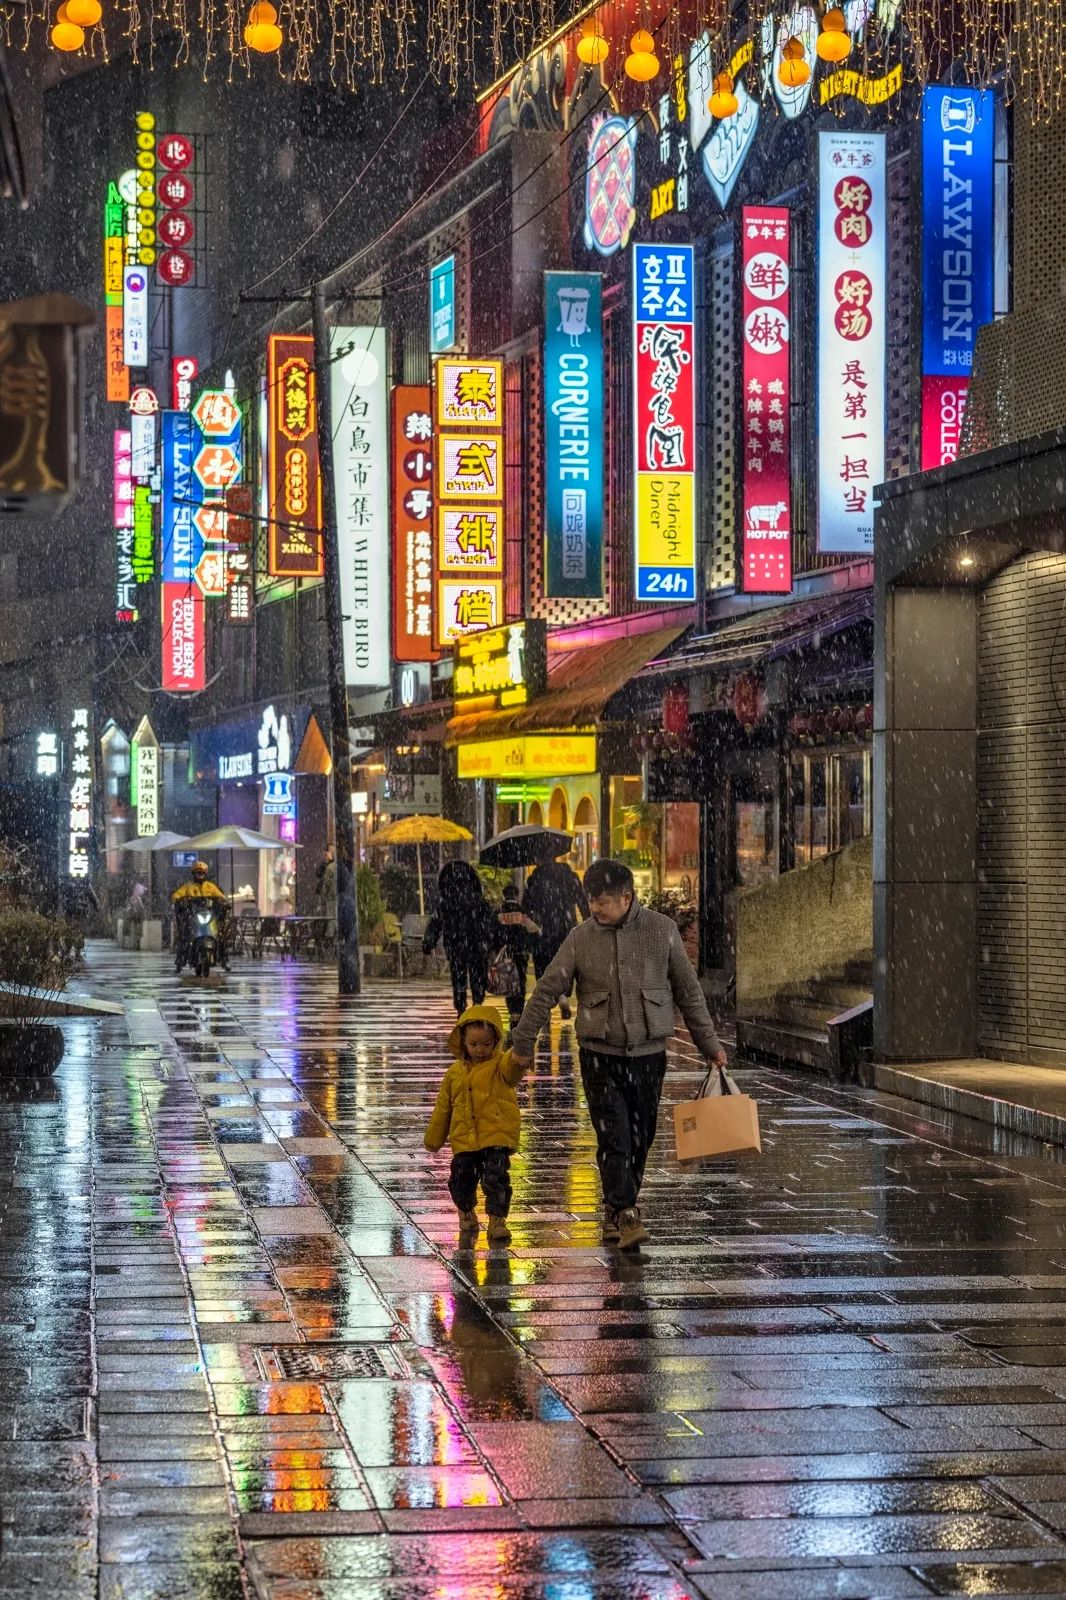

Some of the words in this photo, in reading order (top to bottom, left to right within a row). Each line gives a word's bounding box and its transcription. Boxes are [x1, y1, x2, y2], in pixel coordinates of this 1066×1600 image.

[650, 178, 676, 220] ART
[838, 180, 868, 243] 好肉
[642, 255, 686, 285] 호프
[943, 139, 972, 341] LAWSON
[641, 286, 687, 316] 주소
[838, 277, 868, 337] 好汤
[551, 354, 589, 480] CORNERIE
[839, 360, 869, 513] 是第一担当
[348, 395, 372, 526] 白鳥市集
[173, 442, 191, 563] LAWSON
[650, 481, 664, 528] Diner
[663, 481, 681, 560] Midnight
[747, 530, 768, 539] HOT
[769, 531, 789, 539] POT
[354, 539, 369, 609] WHITE
[646, 573, 687, 592] 24h
[172, 600, 183, 675] COLLECTION
[183, 597, 194, 640] TEDDY
[354, 618, 369, 669] BIRD
[183, 642, 194, 678] BEAR
